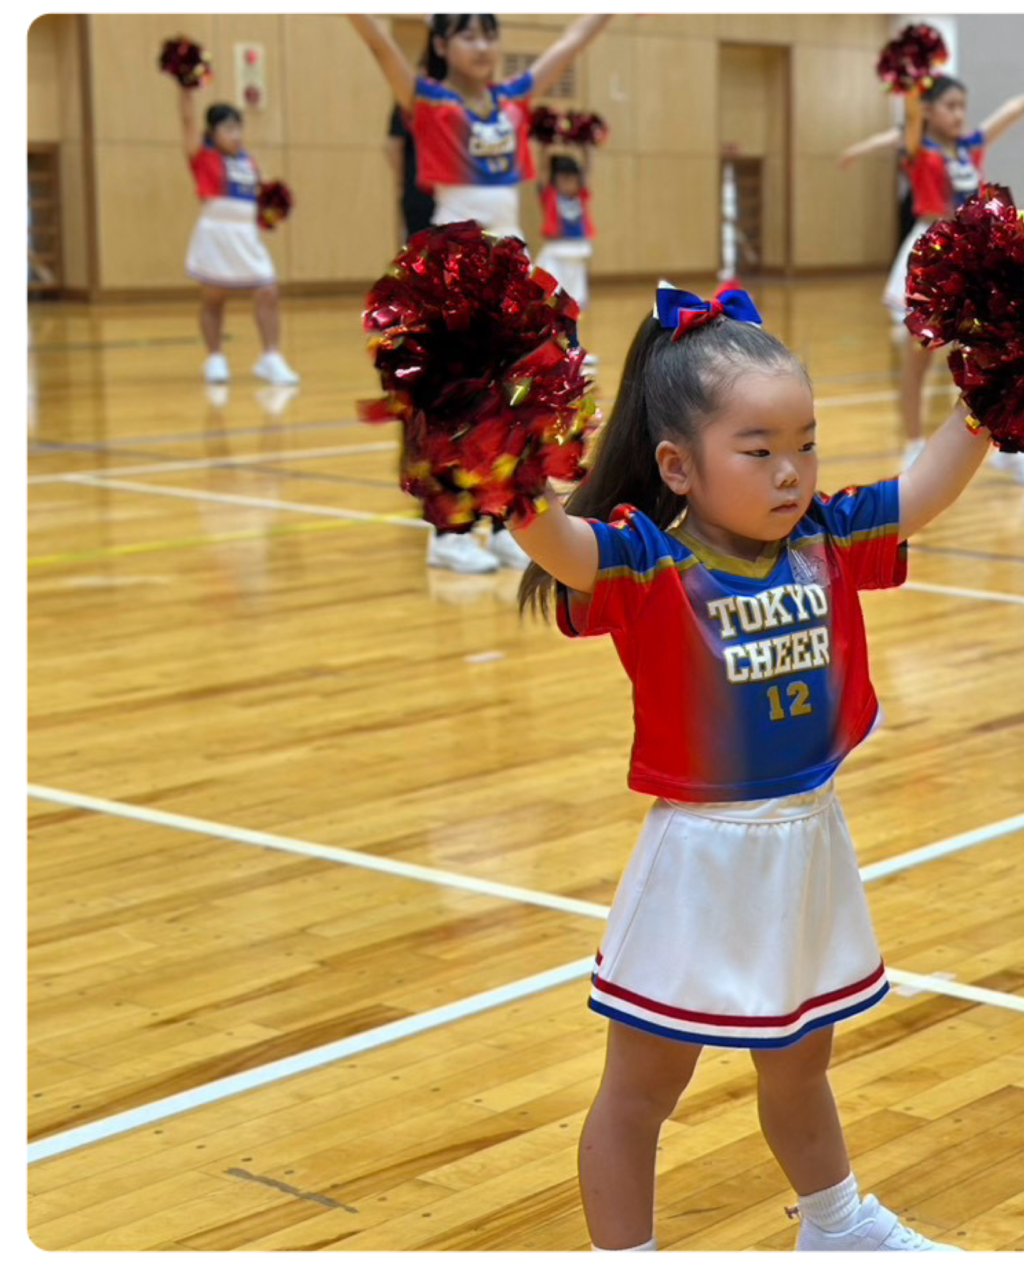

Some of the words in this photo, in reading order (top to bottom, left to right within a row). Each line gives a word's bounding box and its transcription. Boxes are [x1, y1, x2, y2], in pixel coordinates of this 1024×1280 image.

[707, 583, 829, 640] TOKYO
[723, 625, 830, 685] CHEER
[766, 680, 812, 721] 12
